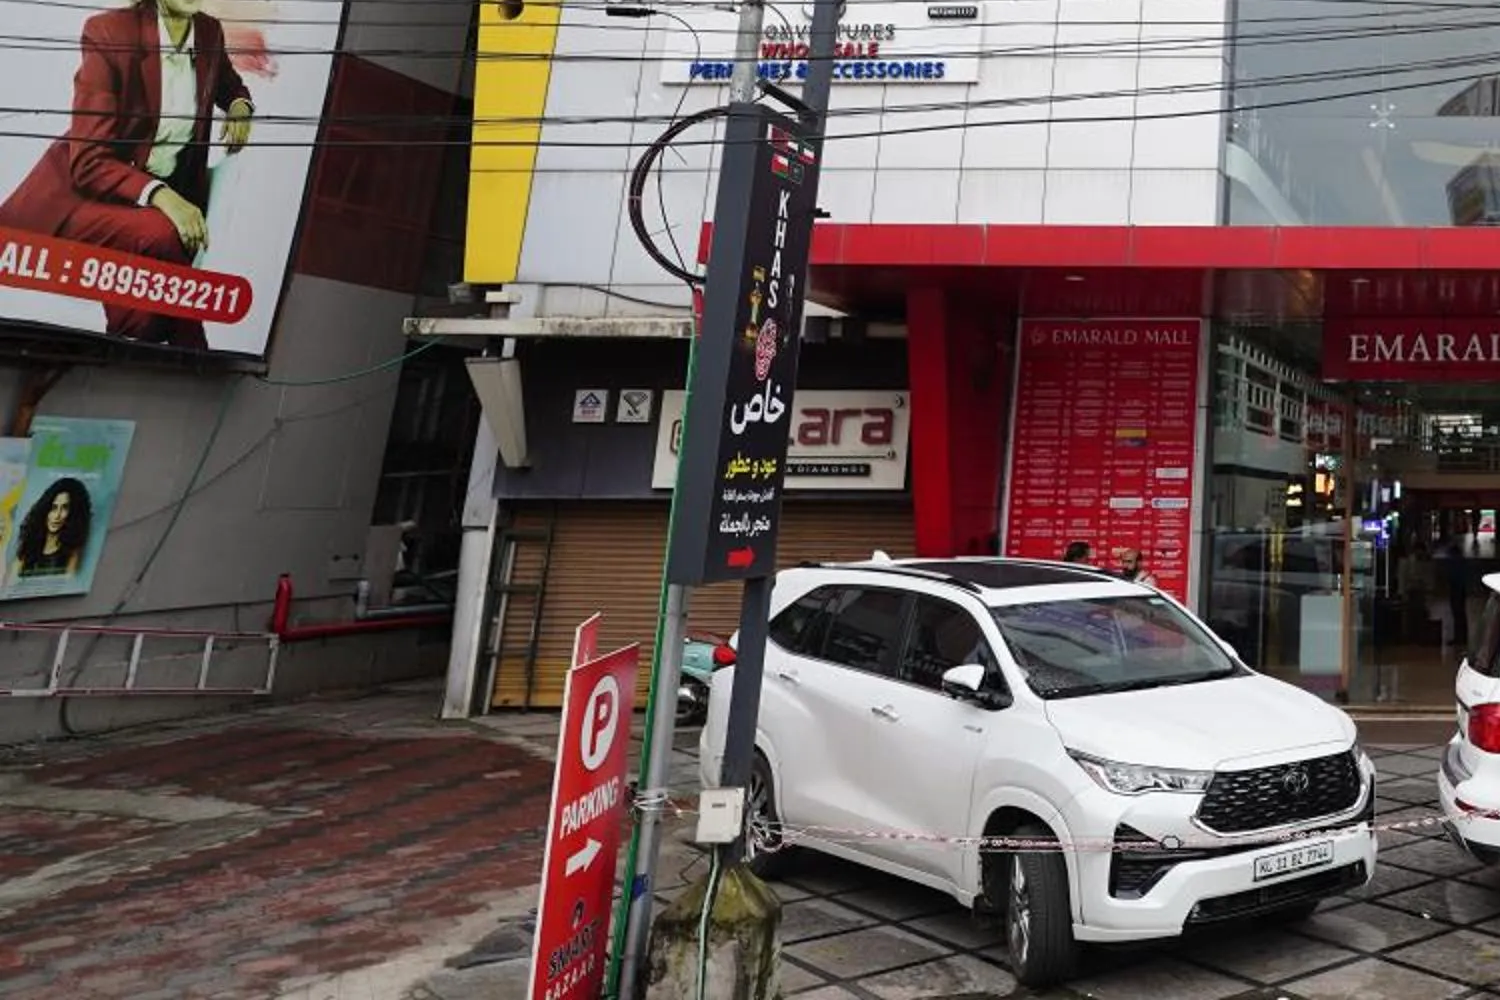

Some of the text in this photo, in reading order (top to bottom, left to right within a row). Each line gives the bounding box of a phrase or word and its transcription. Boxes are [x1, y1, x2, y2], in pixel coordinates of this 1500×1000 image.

[761, 42, 880, 58] WHOSALE
[831, 60, 945, 80] CCESSORIES
[766, 190, 791, 311] KHAS
[79, 257, 241, 314] 9895332211
[1052, 328, 1193, 347] EMARALD MALL
[730, 378, 785, 435] خاص
[559, 775, 620, 841] PARKING
